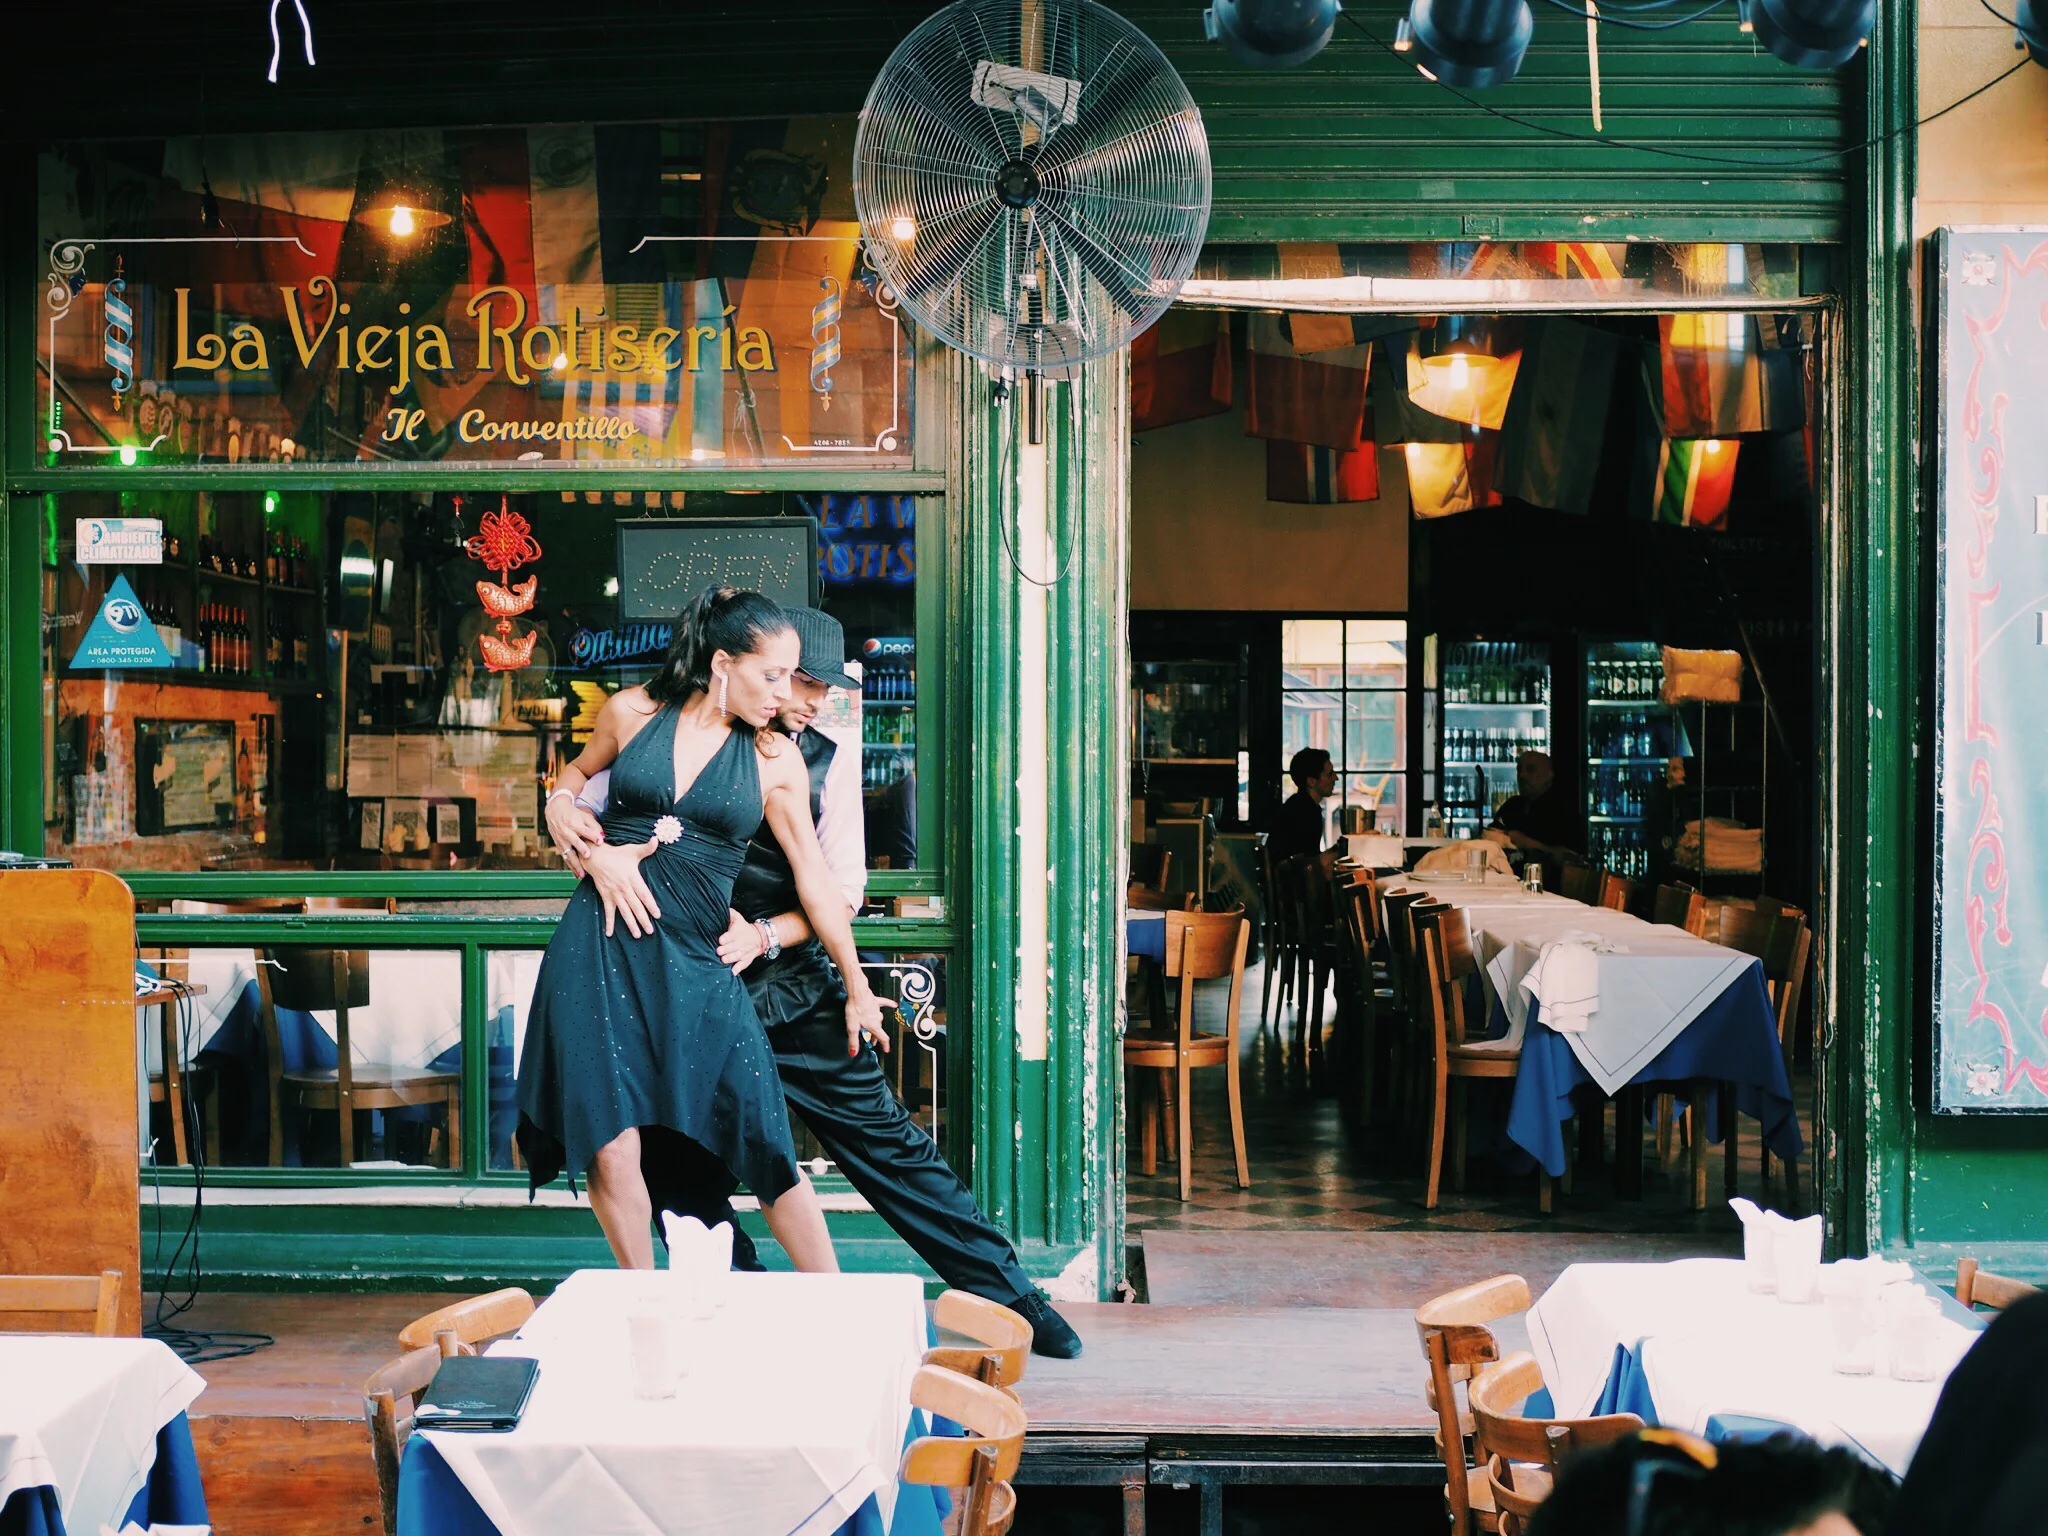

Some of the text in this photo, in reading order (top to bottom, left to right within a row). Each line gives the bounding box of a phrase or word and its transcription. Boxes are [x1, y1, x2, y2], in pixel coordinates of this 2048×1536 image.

[173, 275, 777, 396] La Vieja Rotisería
[458, 408, 640, 444] Conventillo
[80, 546, 158, 560] CLIMATIZADO
[647, 551, 800, 593] OPEN
[111, 647, 156, 655] PROTEGIDA
